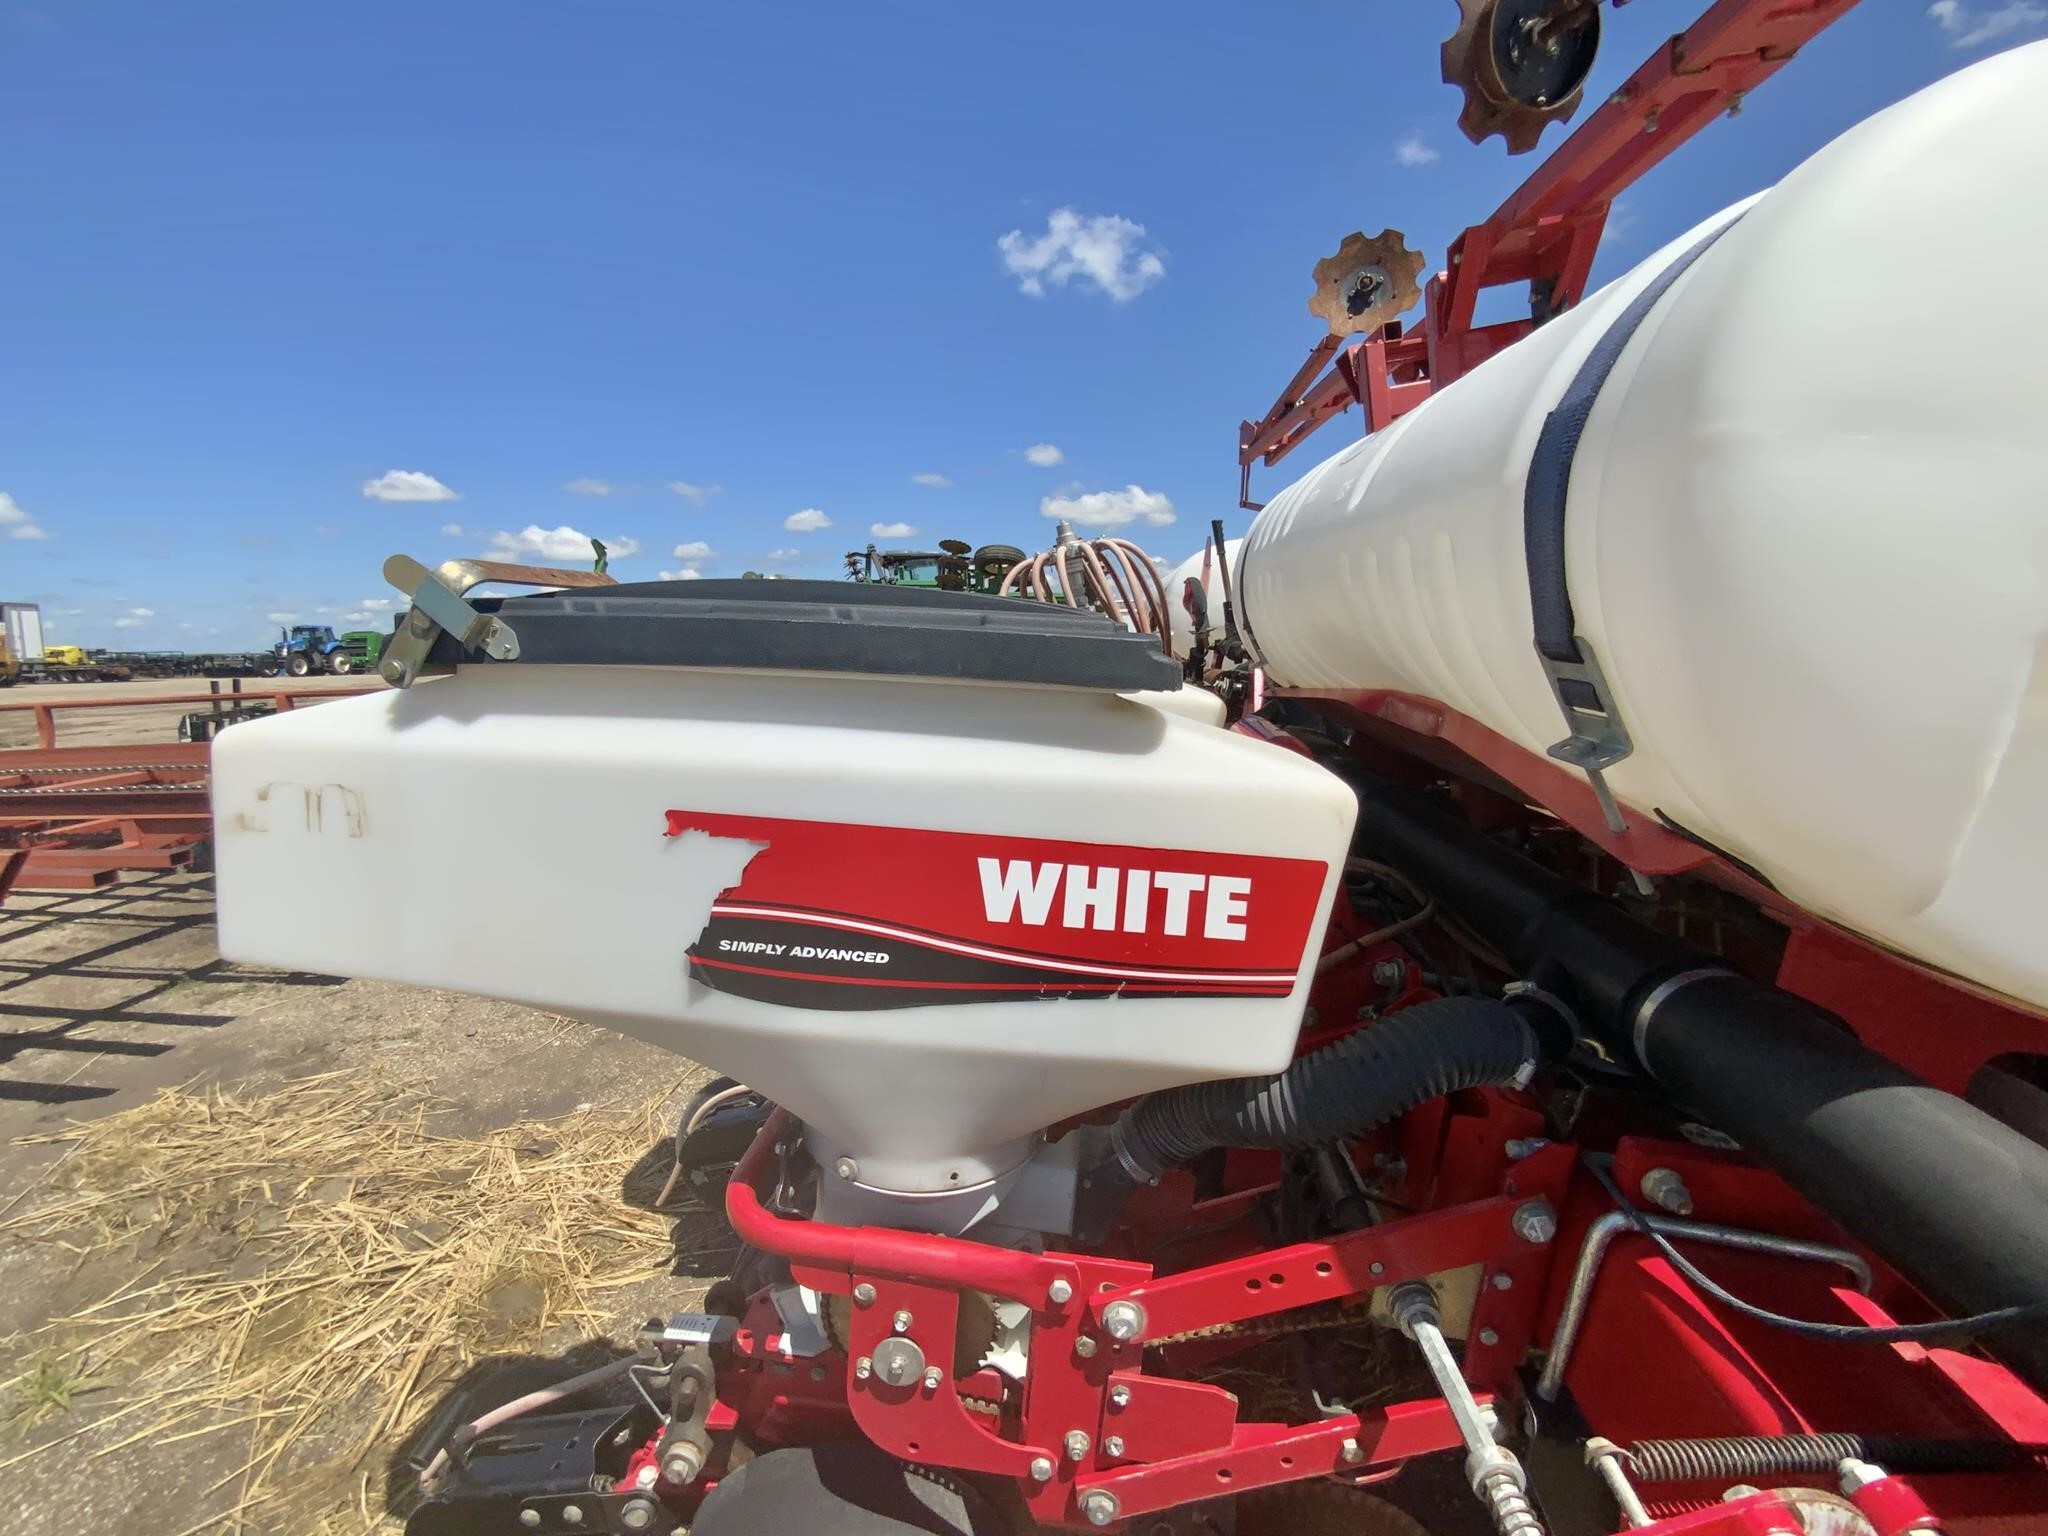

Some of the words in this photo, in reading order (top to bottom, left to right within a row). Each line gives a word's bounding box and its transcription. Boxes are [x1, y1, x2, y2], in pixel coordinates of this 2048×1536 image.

[977, 857, 1252, 941] WHITE
[718, 939, 787, 956] SIMPLY
[789, 945, 890, 964] ADVANCED
